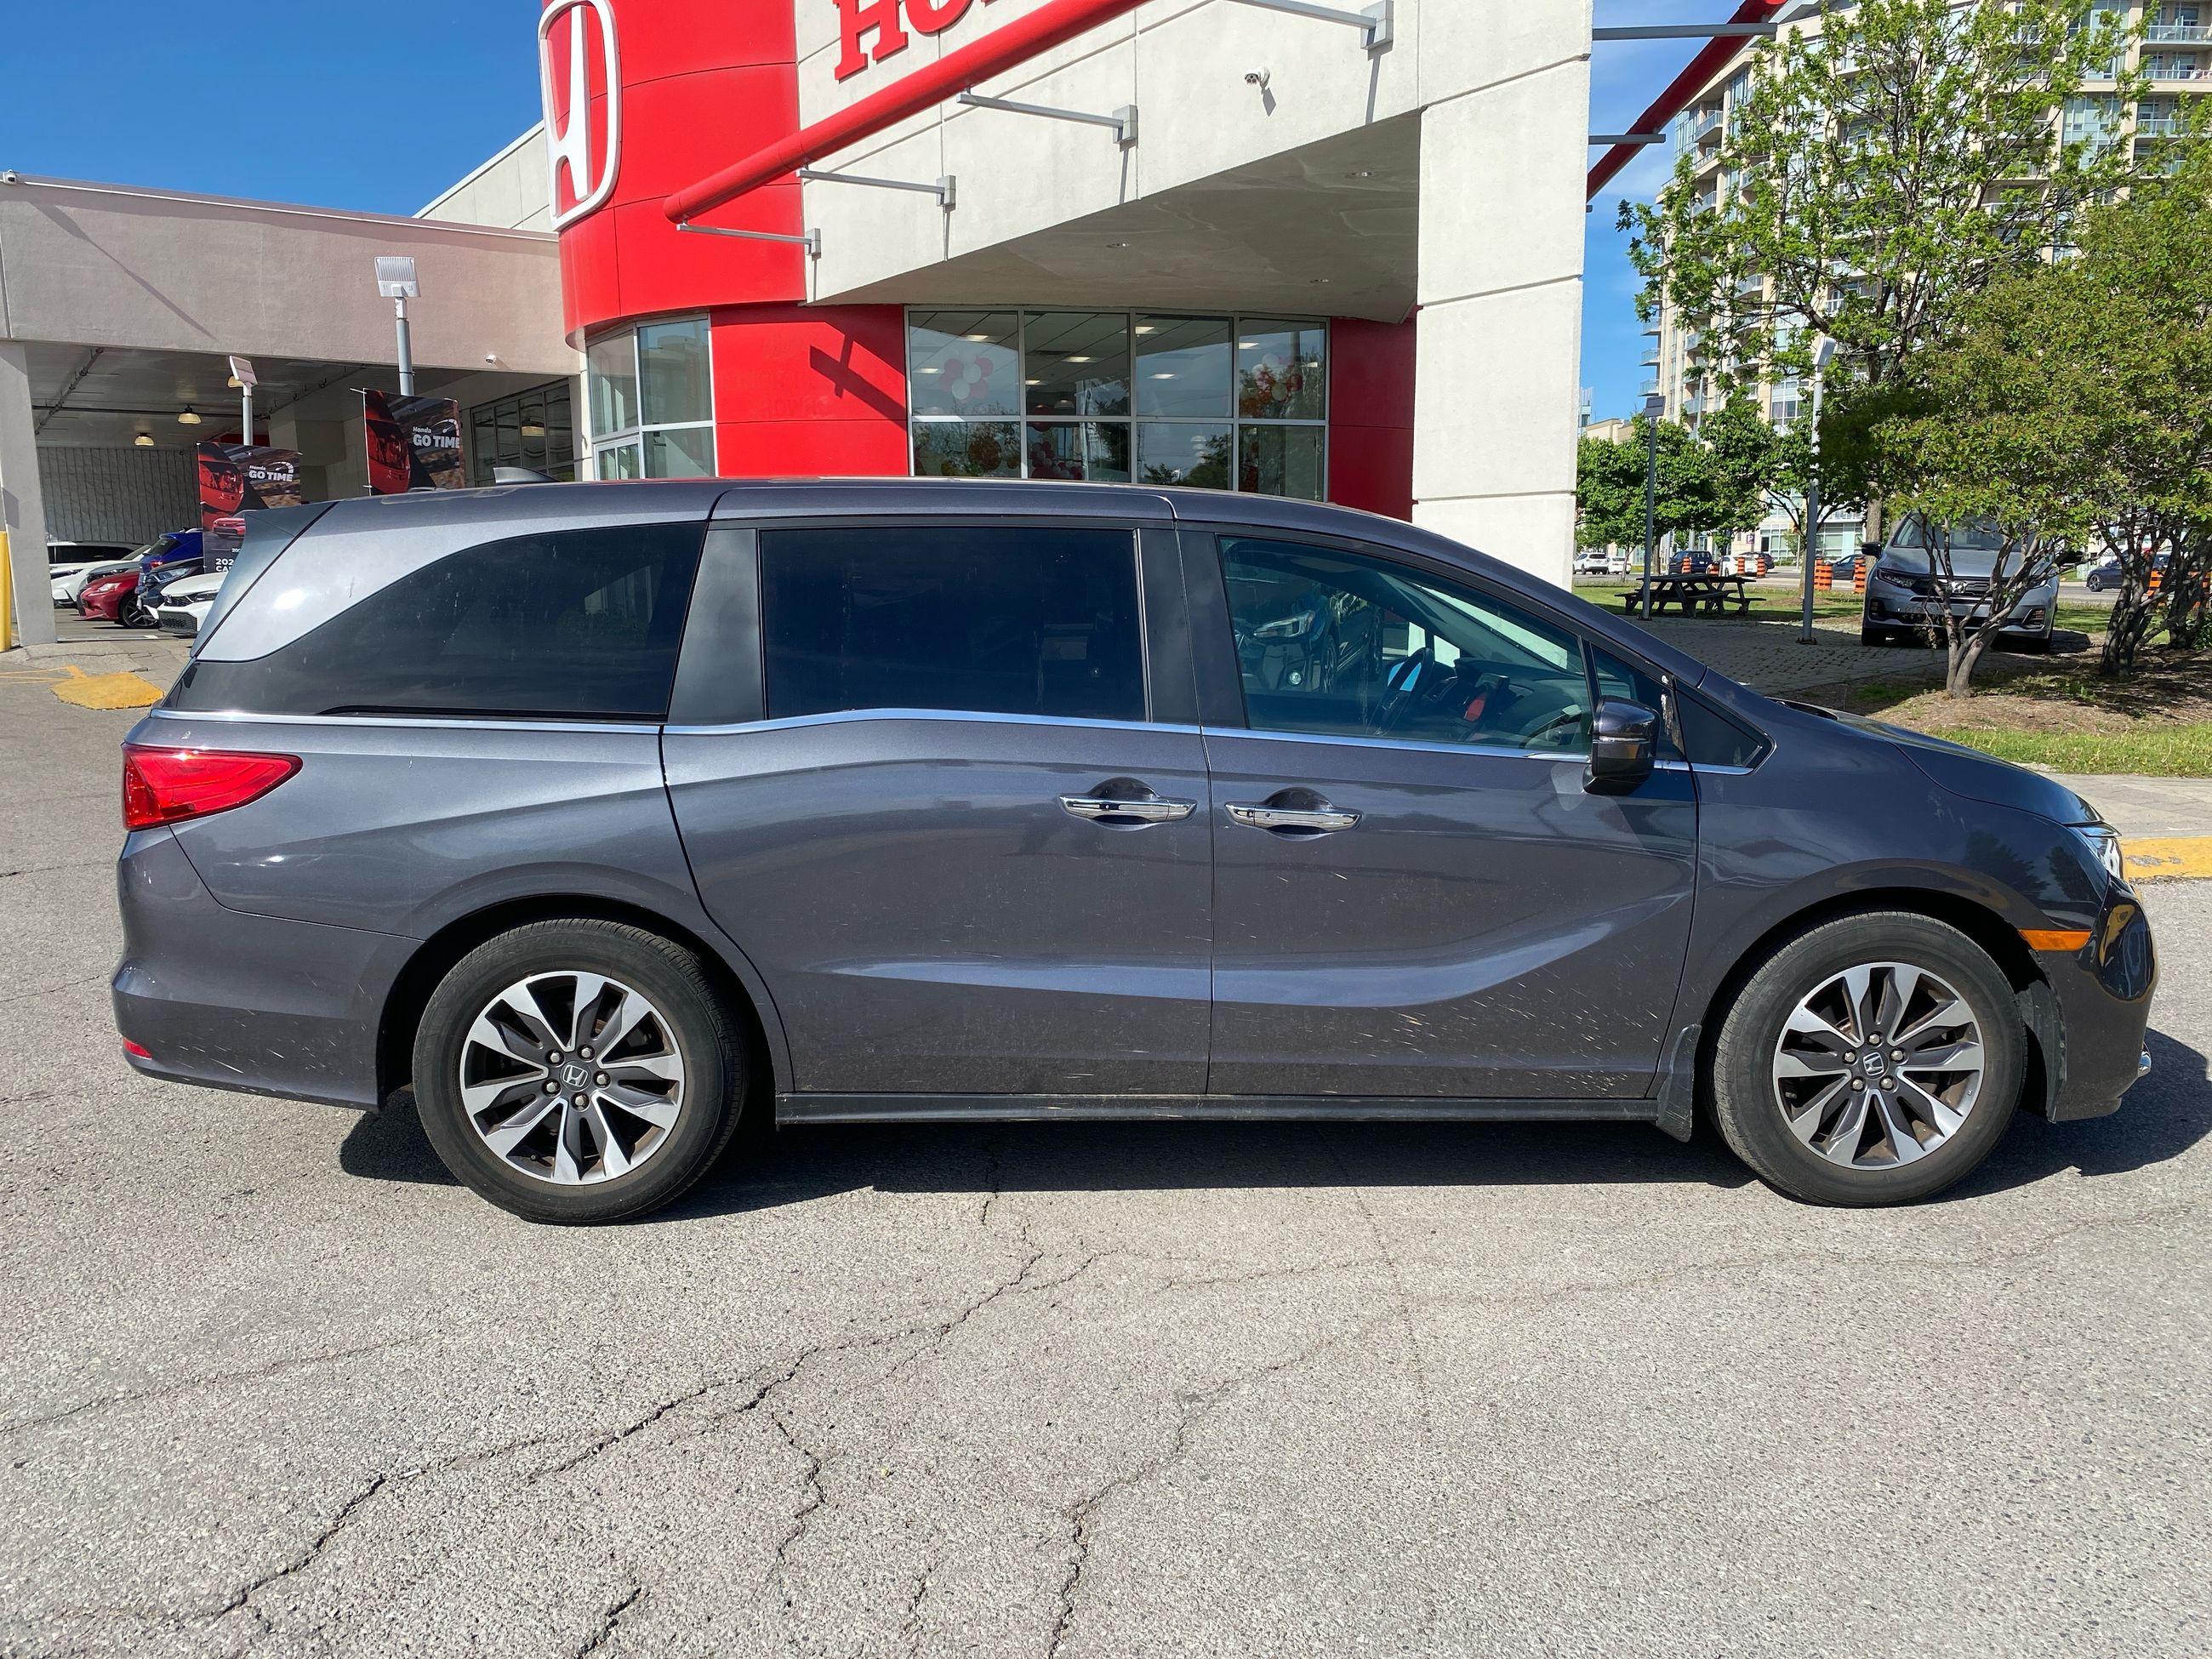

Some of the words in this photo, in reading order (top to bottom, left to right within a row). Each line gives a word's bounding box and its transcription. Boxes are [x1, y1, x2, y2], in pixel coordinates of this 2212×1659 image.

[413, 434, 431, 447] GO
[433, 435, 459, 448] TIME
[248, 470, 265, 479] GO
[266, 471, 294, 482] TIME
